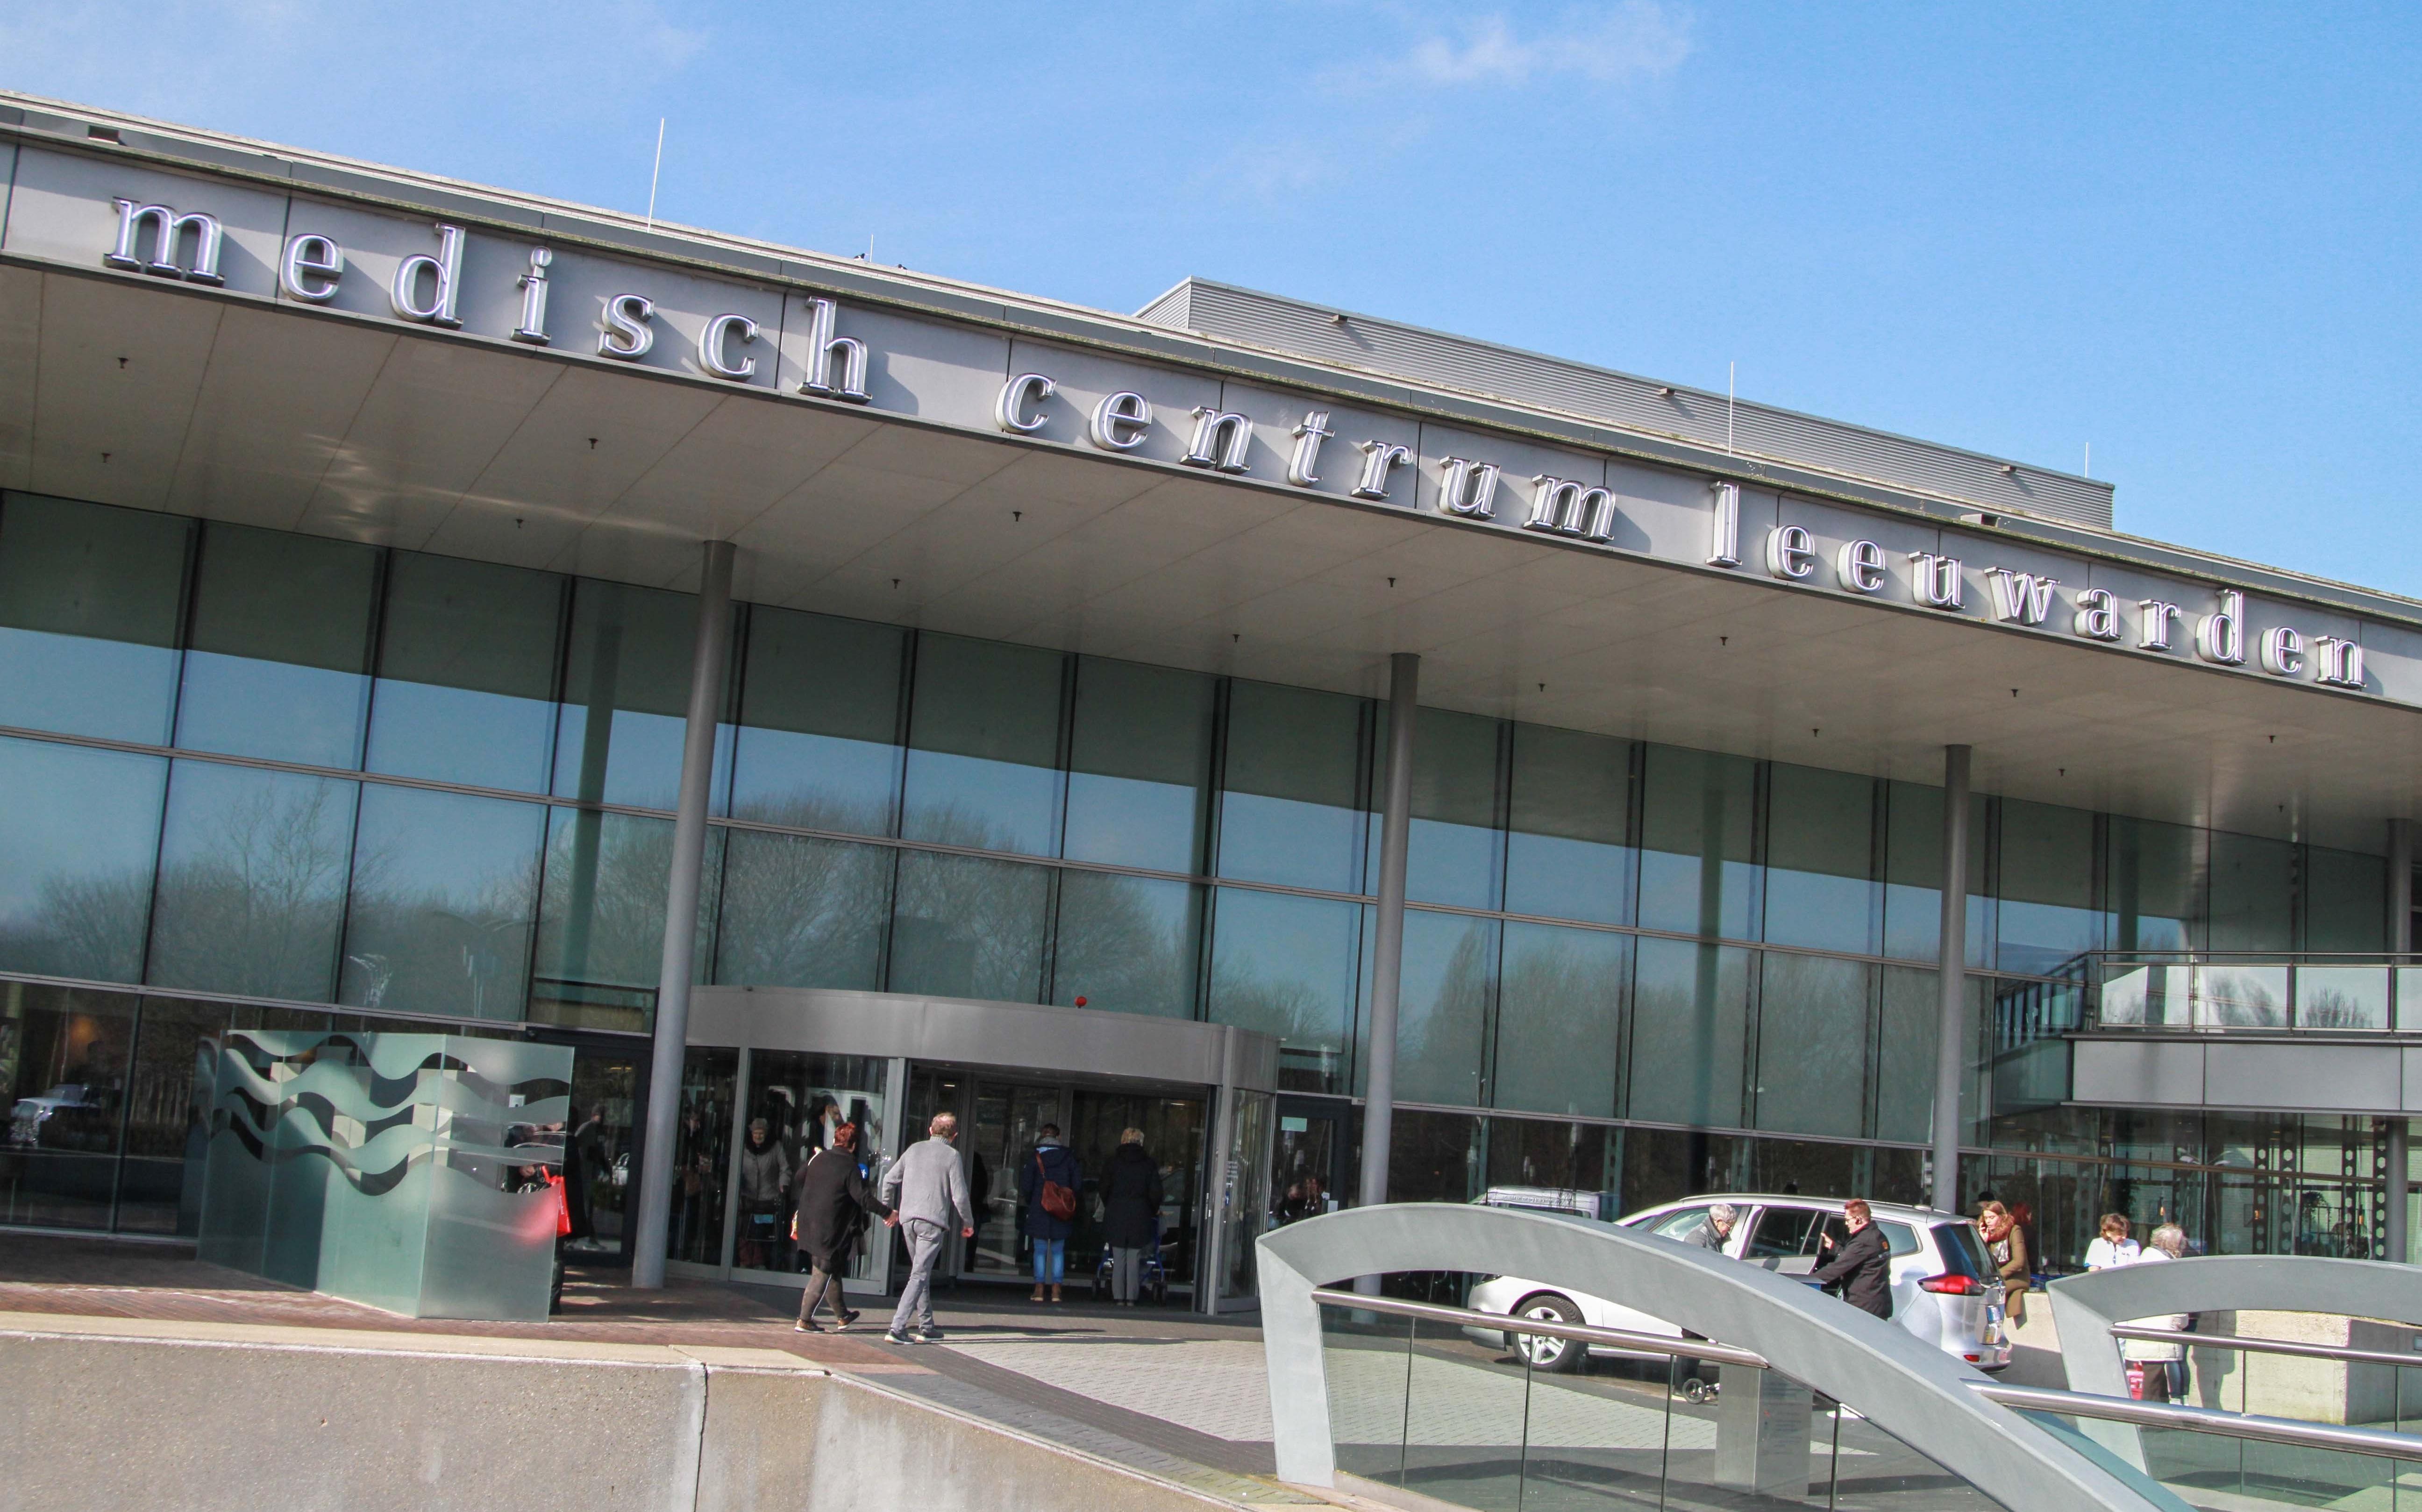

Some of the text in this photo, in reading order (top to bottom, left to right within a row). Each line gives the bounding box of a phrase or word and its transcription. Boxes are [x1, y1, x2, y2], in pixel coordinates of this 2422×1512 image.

[103, 197, 2367, 690] medisch centrum leeuwarden
